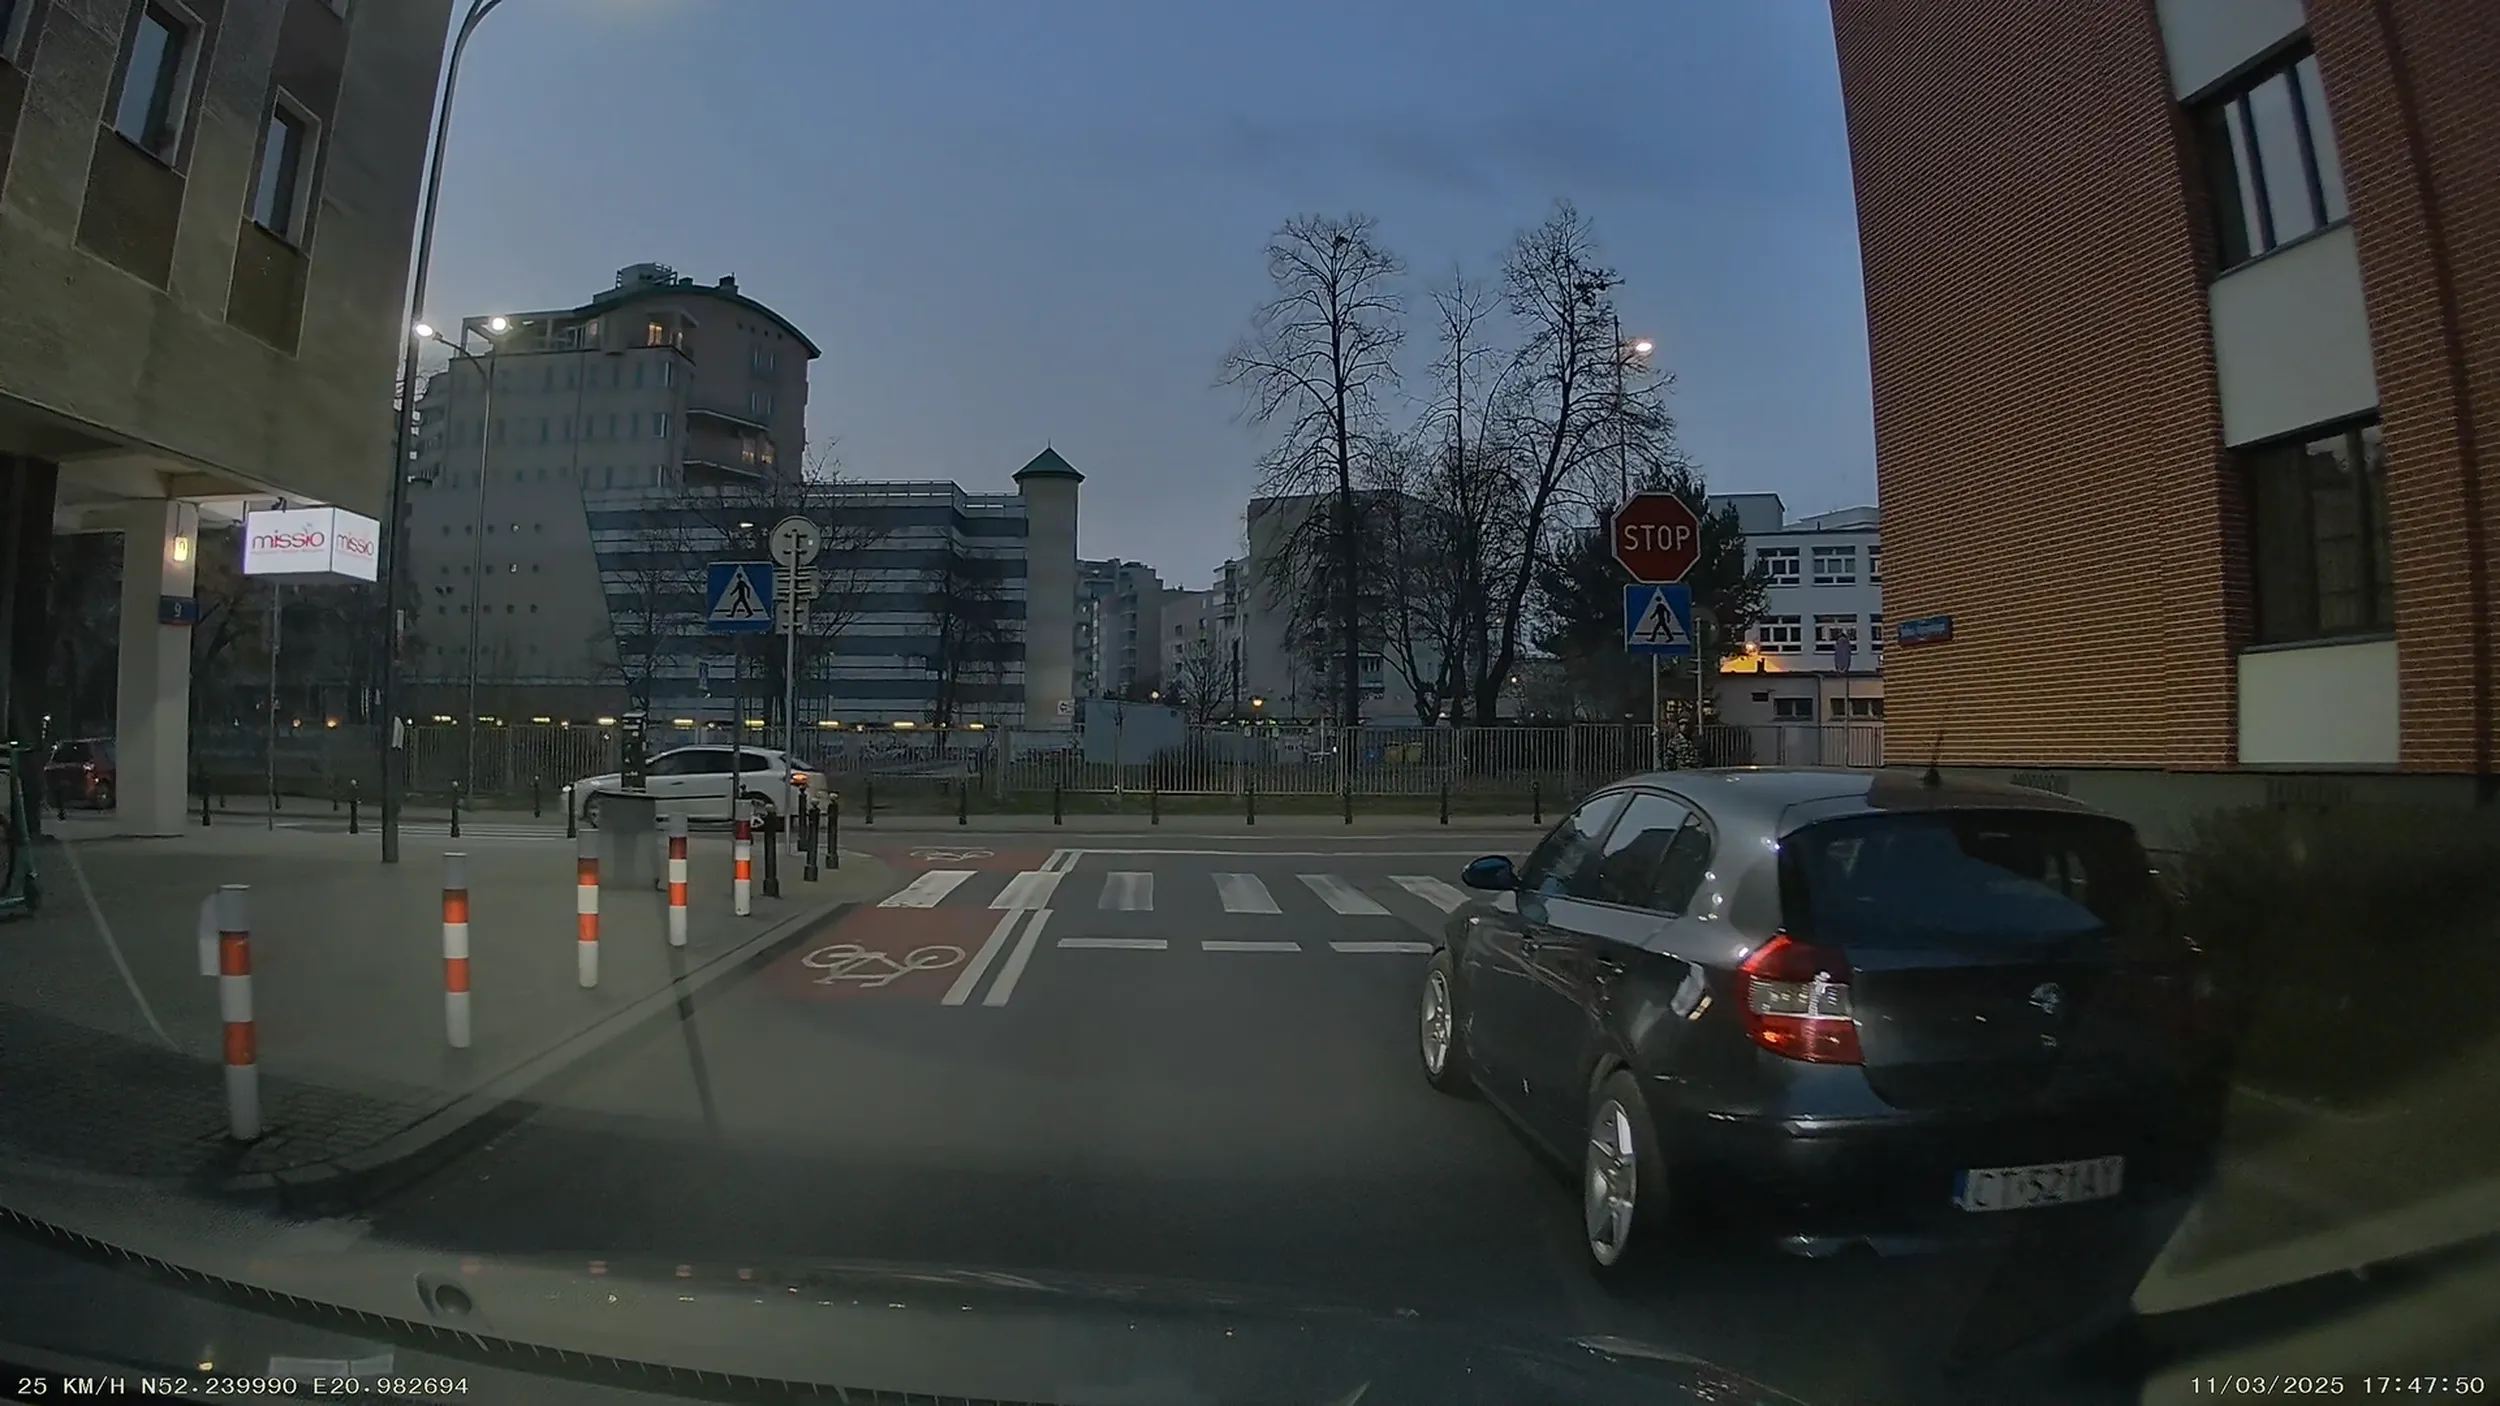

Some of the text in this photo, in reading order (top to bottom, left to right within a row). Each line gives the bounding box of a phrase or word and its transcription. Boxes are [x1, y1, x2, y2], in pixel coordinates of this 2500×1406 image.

[252, 529, 325, 549] missio
[336, 532, 375, 556] missio
[1624, 524, 1690, 551] STOP
[174, 602, 182, 618] 9
